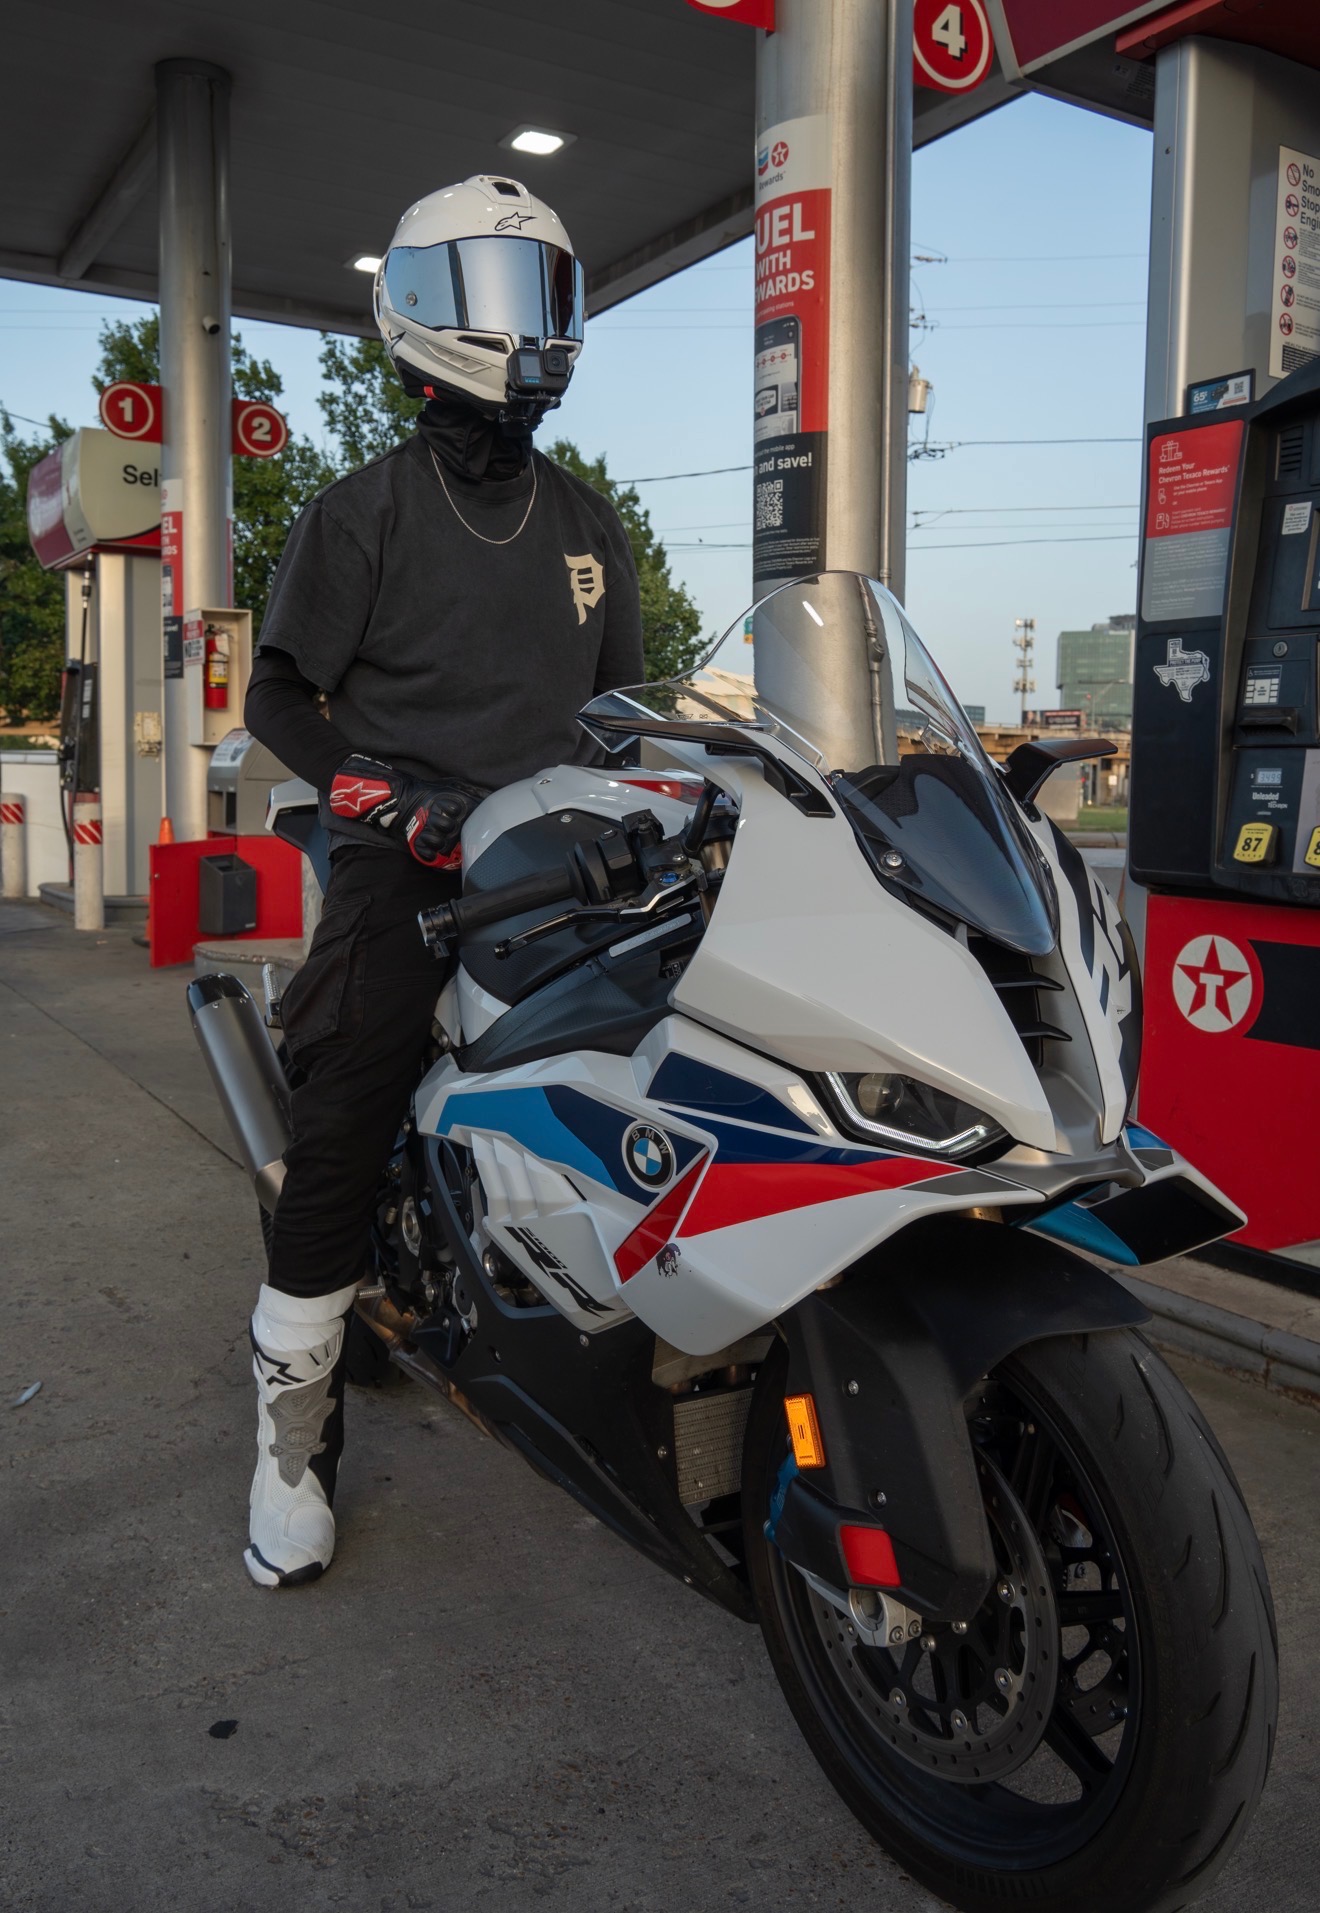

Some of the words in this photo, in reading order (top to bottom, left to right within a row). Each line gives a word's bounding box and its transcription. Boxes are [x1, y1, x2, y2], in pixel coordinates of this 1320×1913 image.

[932, 4, 966, 58] 4
[1303, 163, 1314, 179] No
[755, 202, 815, 254] UEL
[757, 249, 791, 280] WITH
[118, 396, 134, 423] 1
[251, 416, 272, 442] 2
[759, 456, 775, 474] and
[777, 452, 812, 470] save!
[1159, 465, 1181, 475] Redeem
[1159, 475, 1182, 484] Chevron
[1183, 472, 1202, 480] Texaco
[1252, 792, 1280, 801] Unleaded
[1241, 837, 1264, 853] 87
[631, 1128, 670, 1154] BMW
